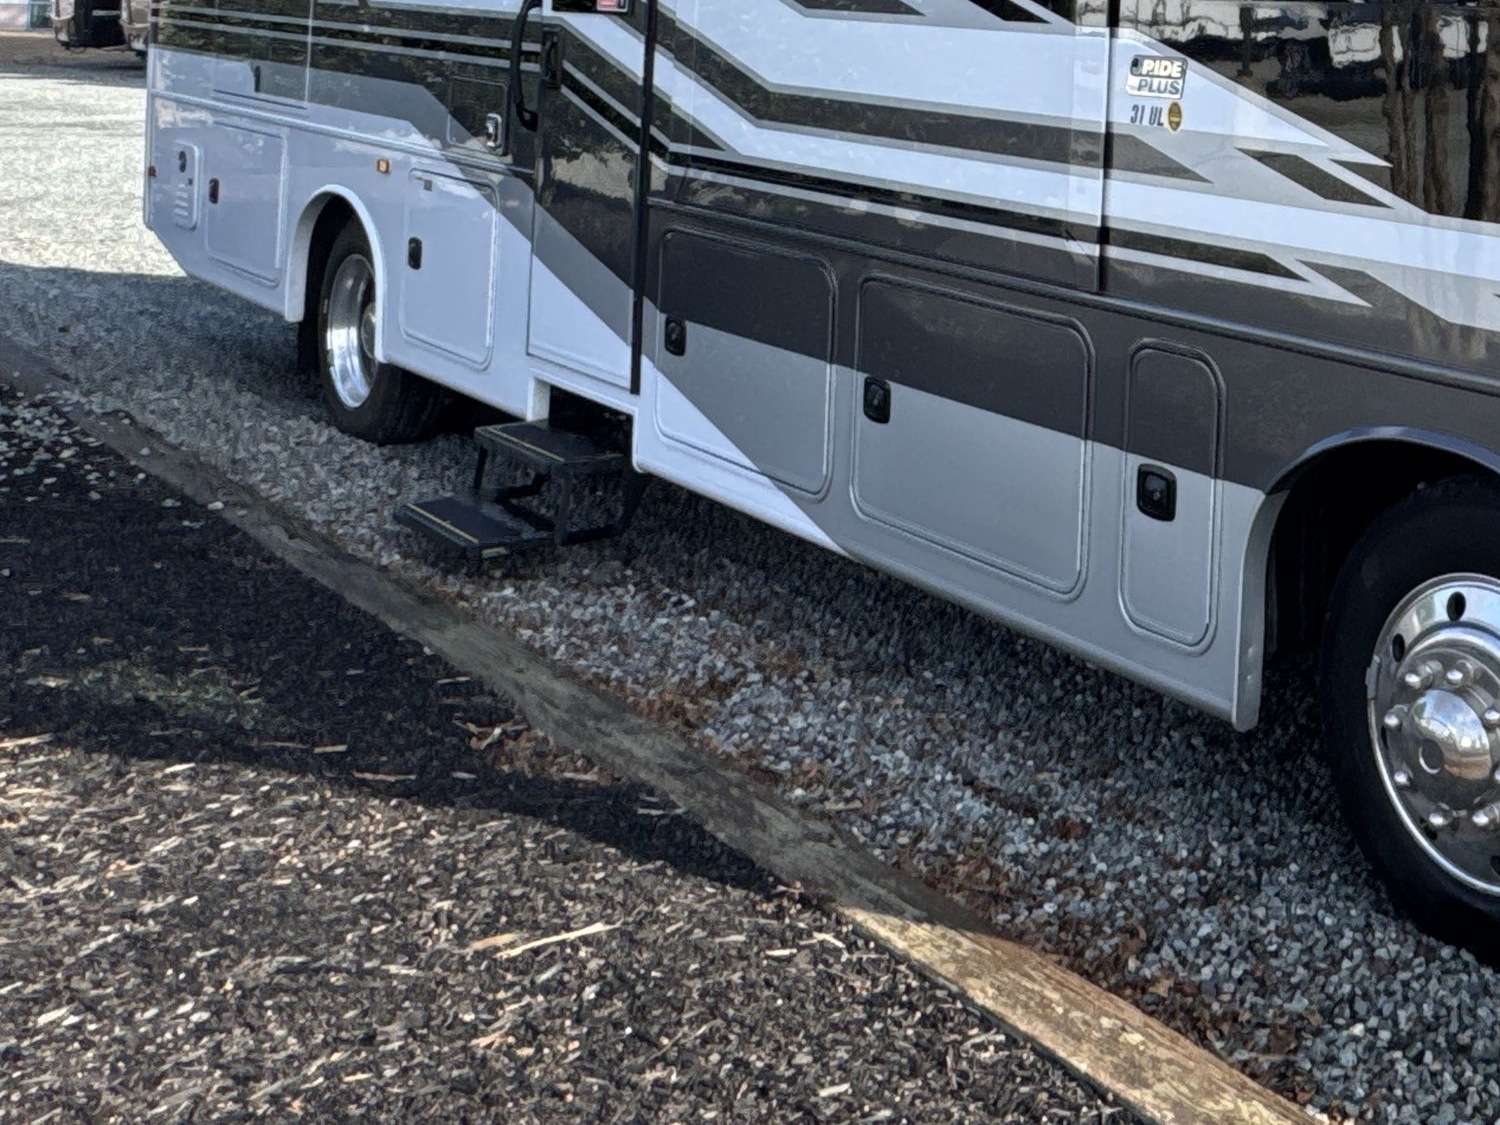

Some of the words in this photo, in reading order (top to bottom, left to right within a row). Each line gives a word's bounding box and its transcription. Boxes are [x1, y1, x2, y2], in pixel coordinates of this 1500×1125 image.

[1137, 78, 1180, 95] PLUS
[1130, 103, 1146, 125] 31
[1148, 105, 1164, 127] UL
